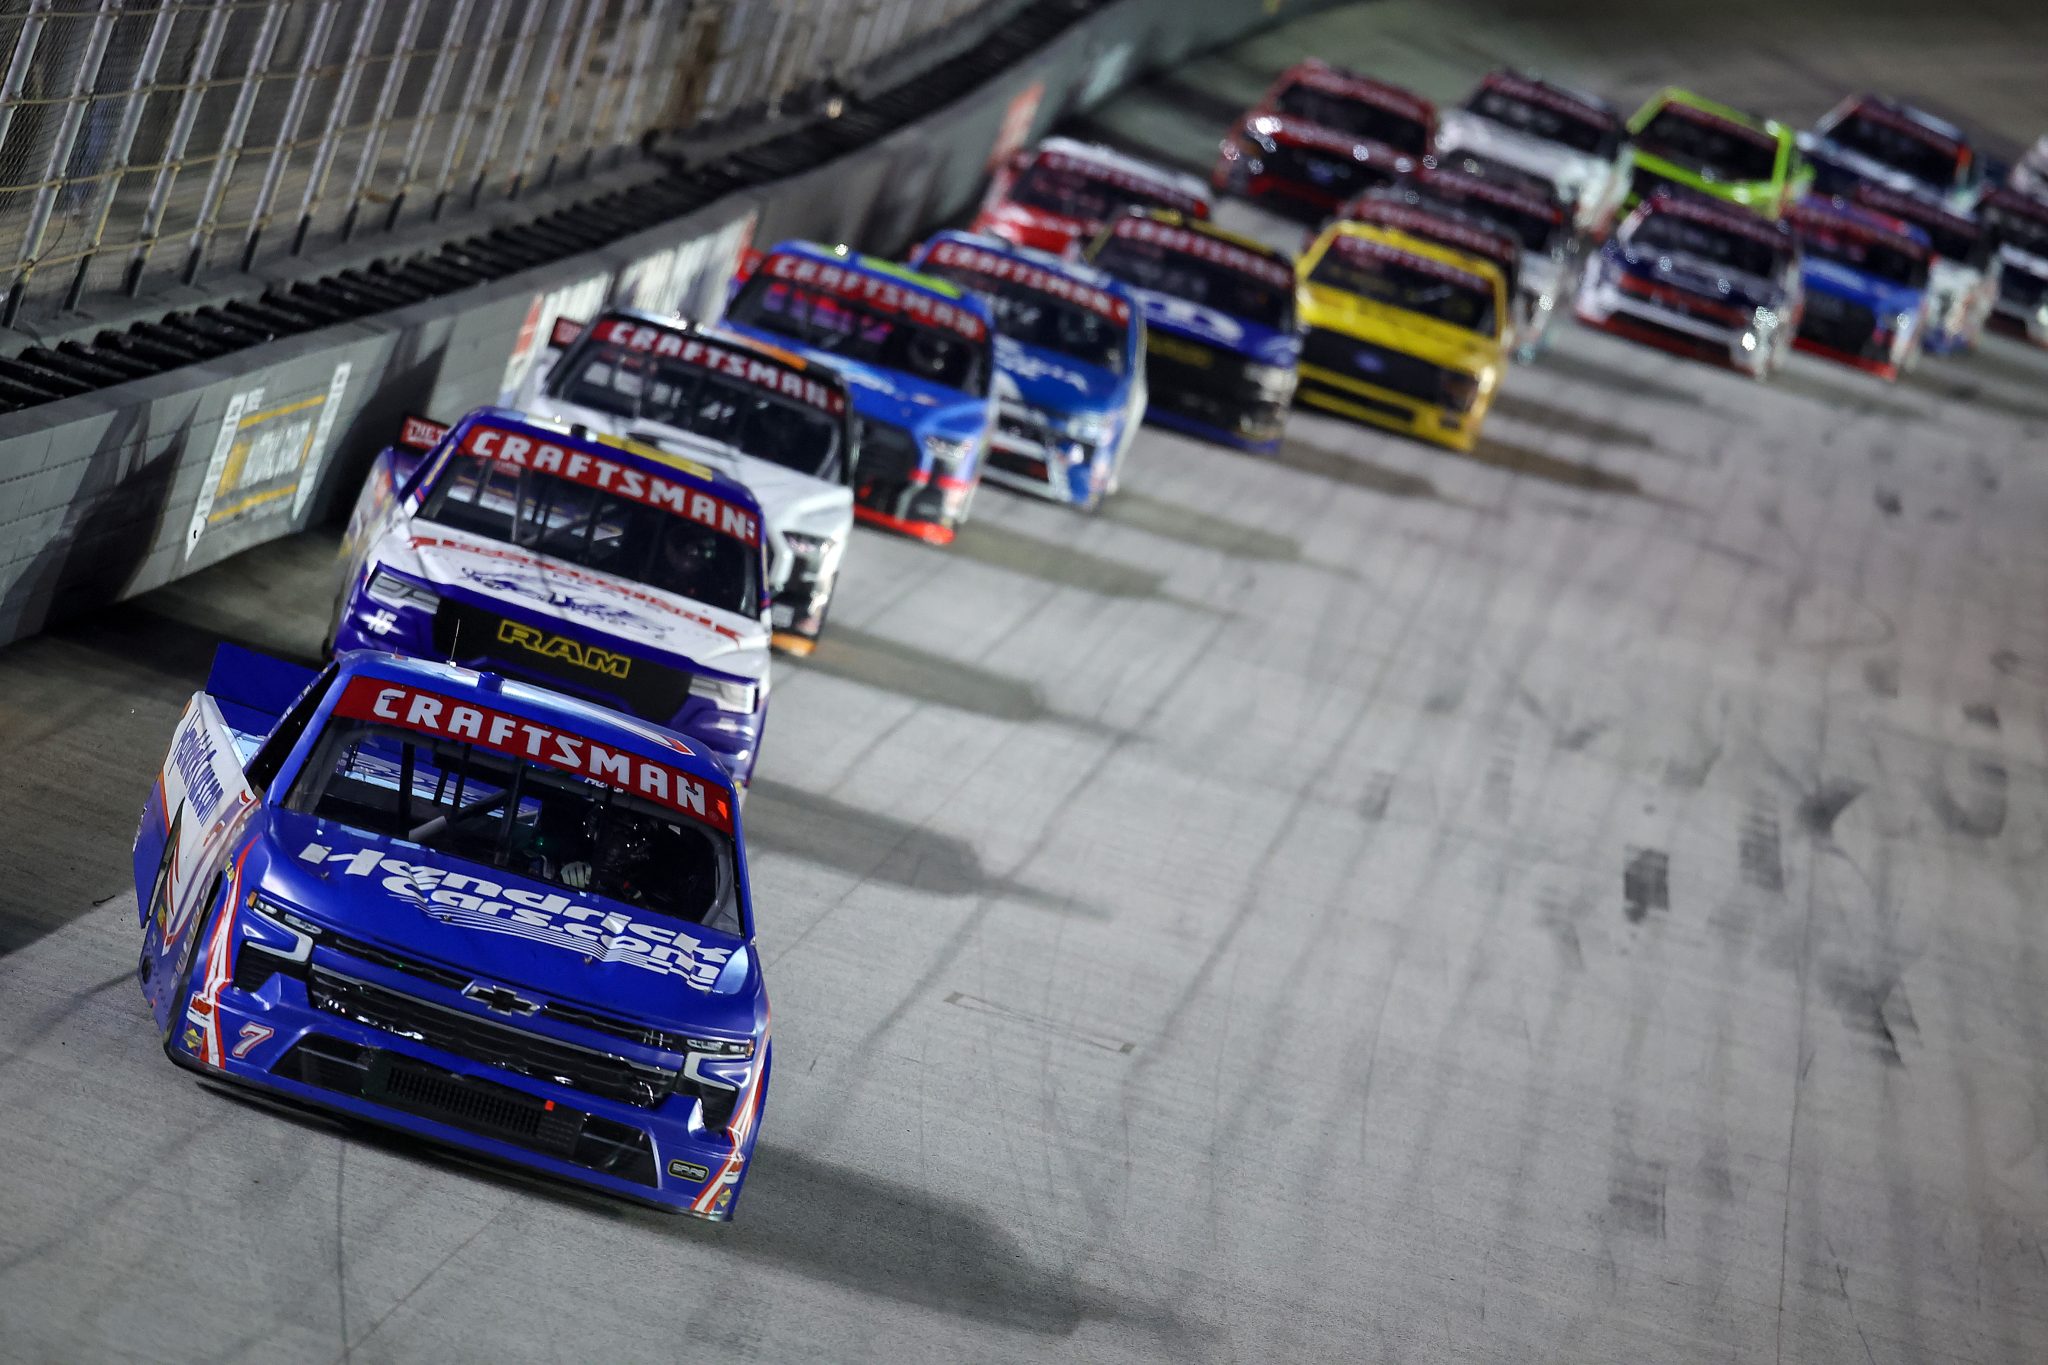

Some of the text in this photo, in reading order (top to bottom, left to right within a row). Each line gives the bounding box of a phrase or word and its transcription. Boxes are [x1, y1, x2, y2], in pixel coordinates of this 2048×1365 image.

[608, 321, 827, 407] CRAFTSMAN
[472, 431, 746, 539] CRAFTSMAN
[498, 619, 631, 678] RAM
[373, 688, 705, 816] CRAFTSMAN
[299, 843, 733, 964] Hendrick
[382, 876, 720, 980] Cars.com
[232, 1021, 275, 1058] 7
